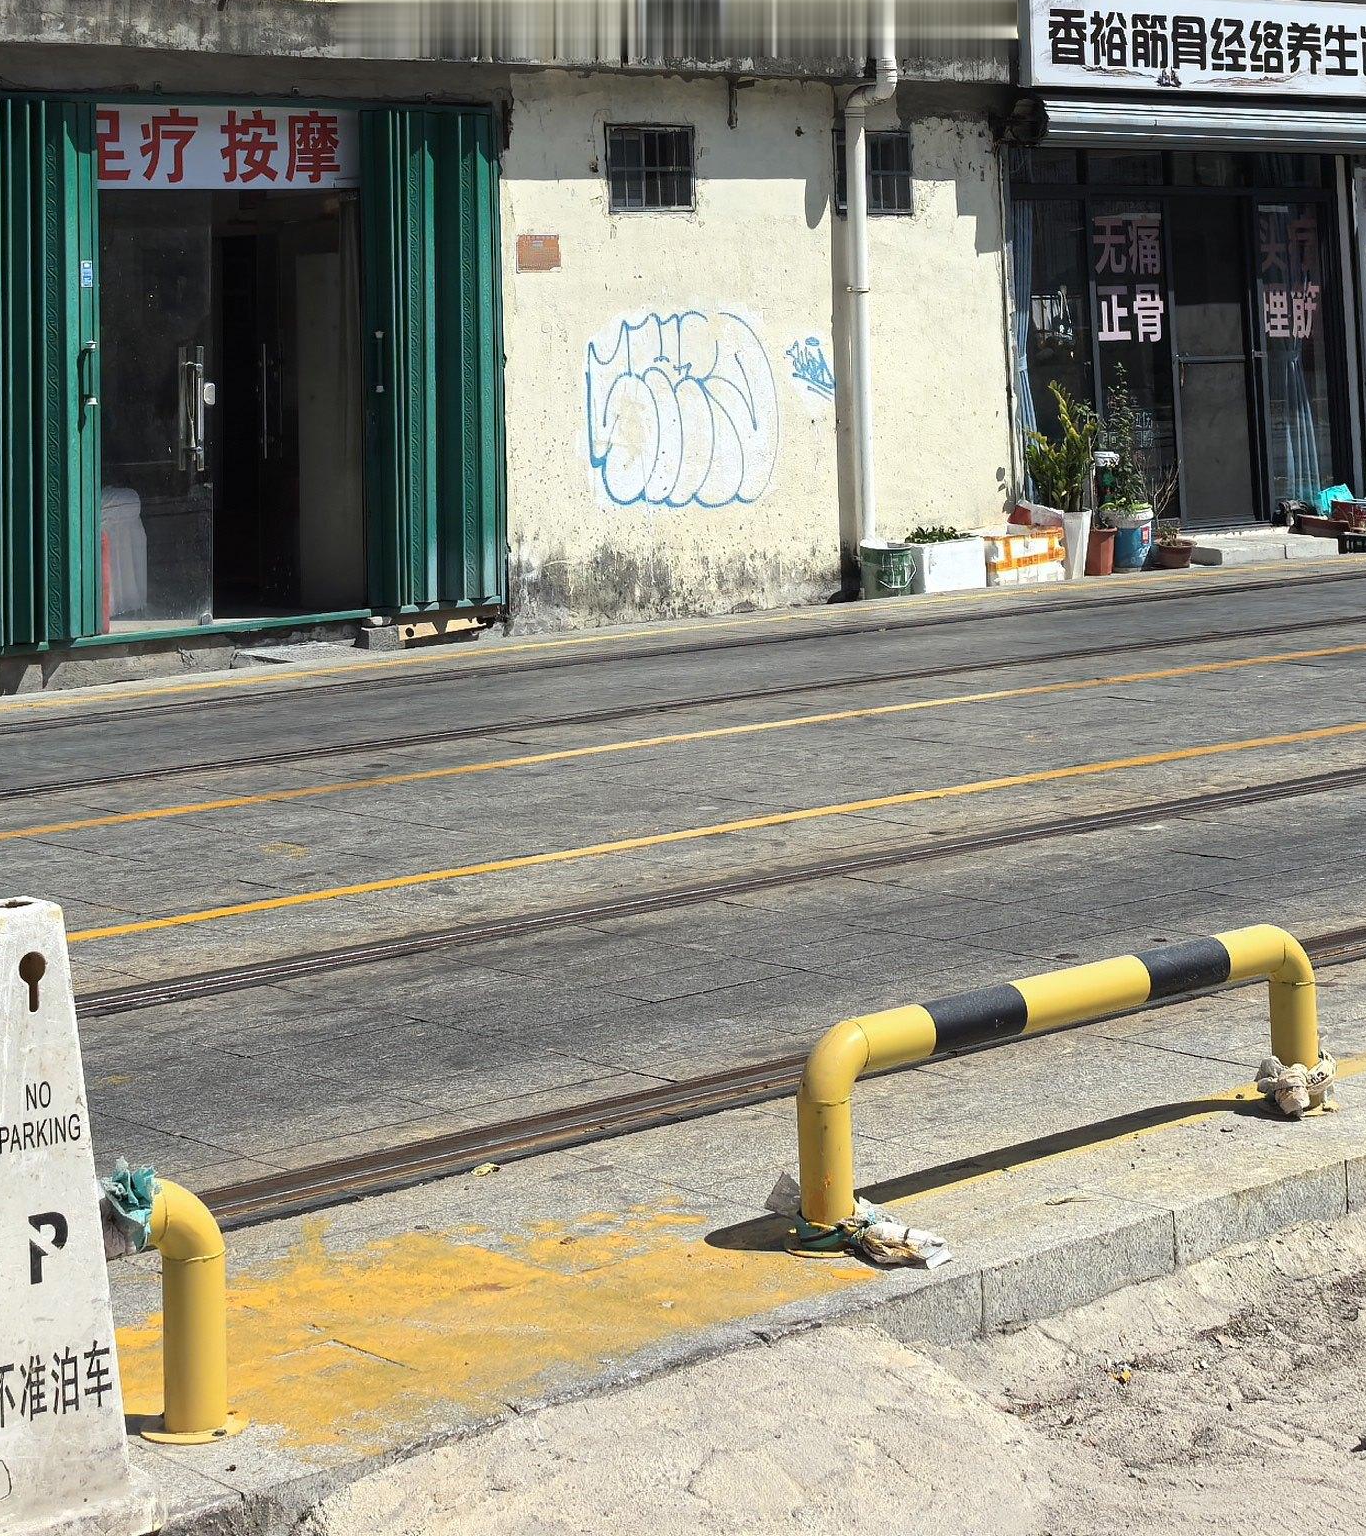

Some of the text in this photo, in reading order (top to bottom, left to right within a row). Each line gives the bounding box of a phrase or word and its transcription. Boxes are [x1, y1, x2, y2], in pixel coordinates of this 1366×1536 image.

[220, 109, 340, 183] 按摩
[1092, 216, 1161, 275] 无痛
[1097, 283, 1164, 343] 正骨
[25, 1080, 51, 1111] NO
[0, 1113, 81, 1154] PARKING
